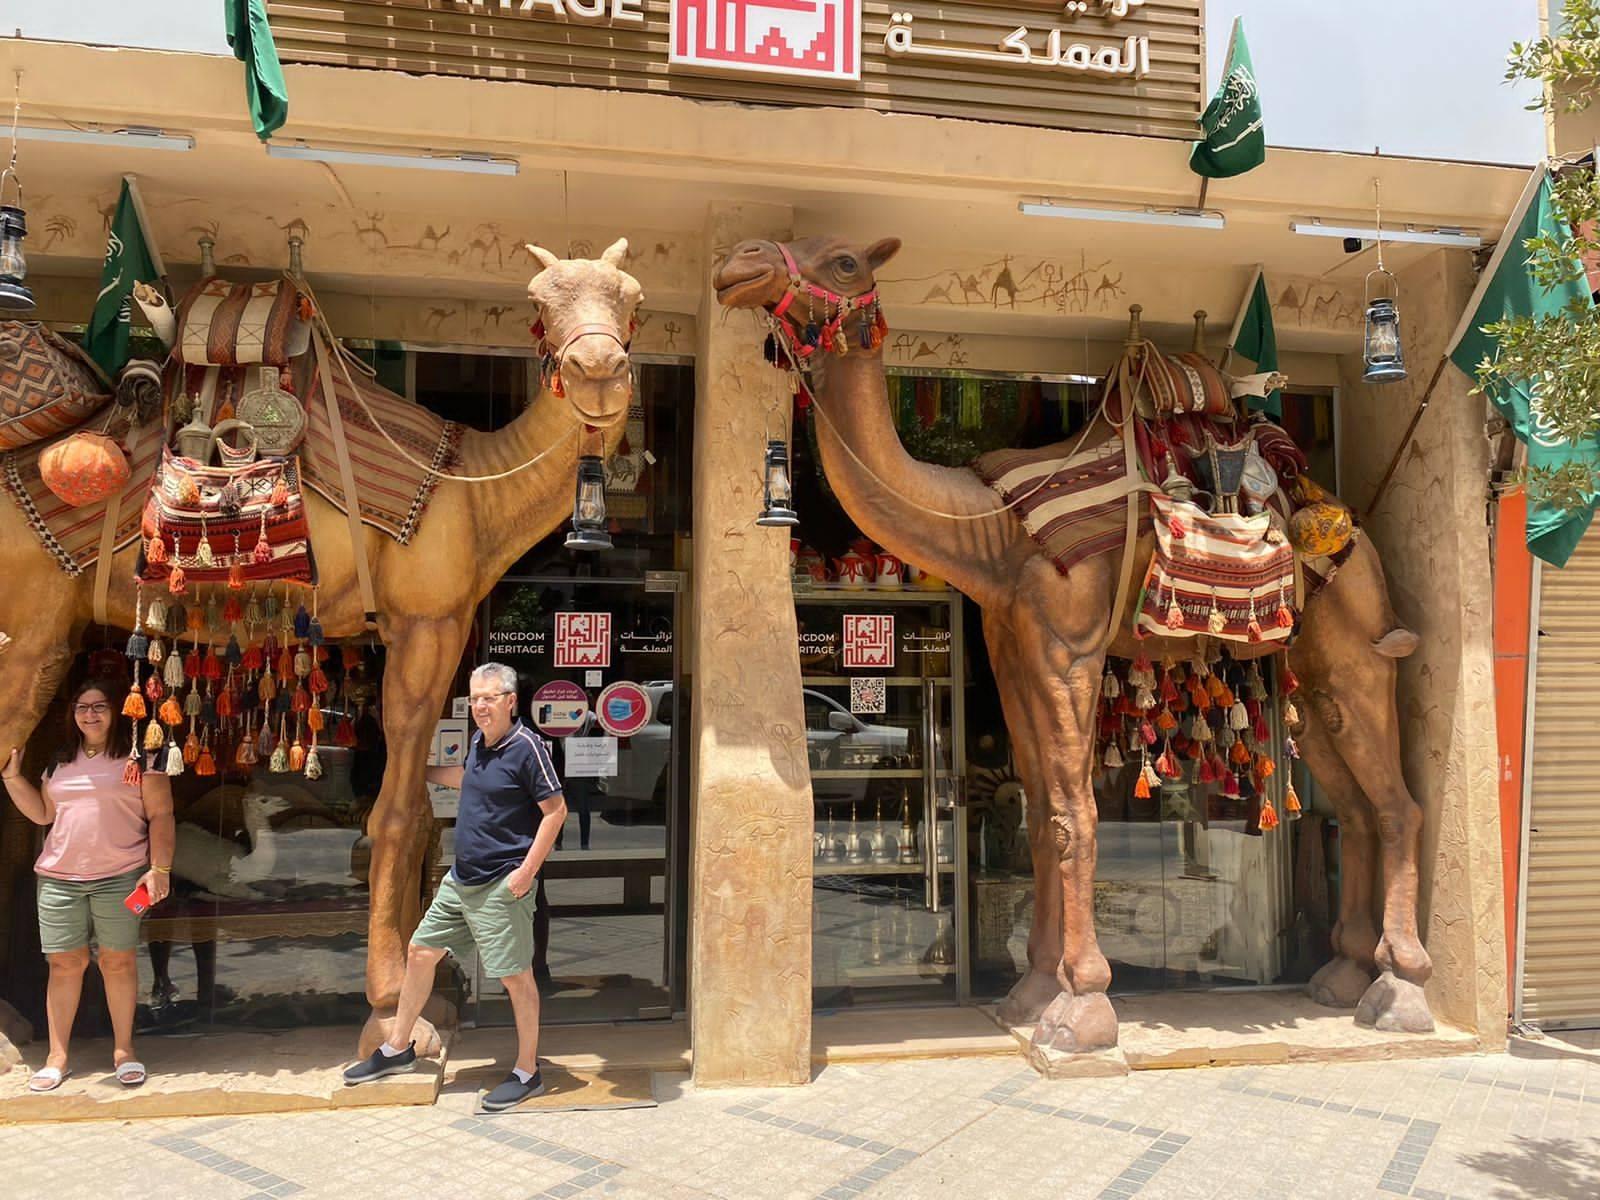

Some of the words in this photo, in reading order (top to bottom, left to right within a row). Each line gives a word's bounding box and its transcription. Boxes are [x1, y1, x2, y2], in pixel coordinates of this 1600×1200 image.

[884, 11, 1150, 75] المملكة
[489, 631, 545, 641] KINGDOM
[620, 629, 673, 642] تراثيات
[489, 644, 545, 654] HERITAGE
[619, 643, 673, 653] المملكة
